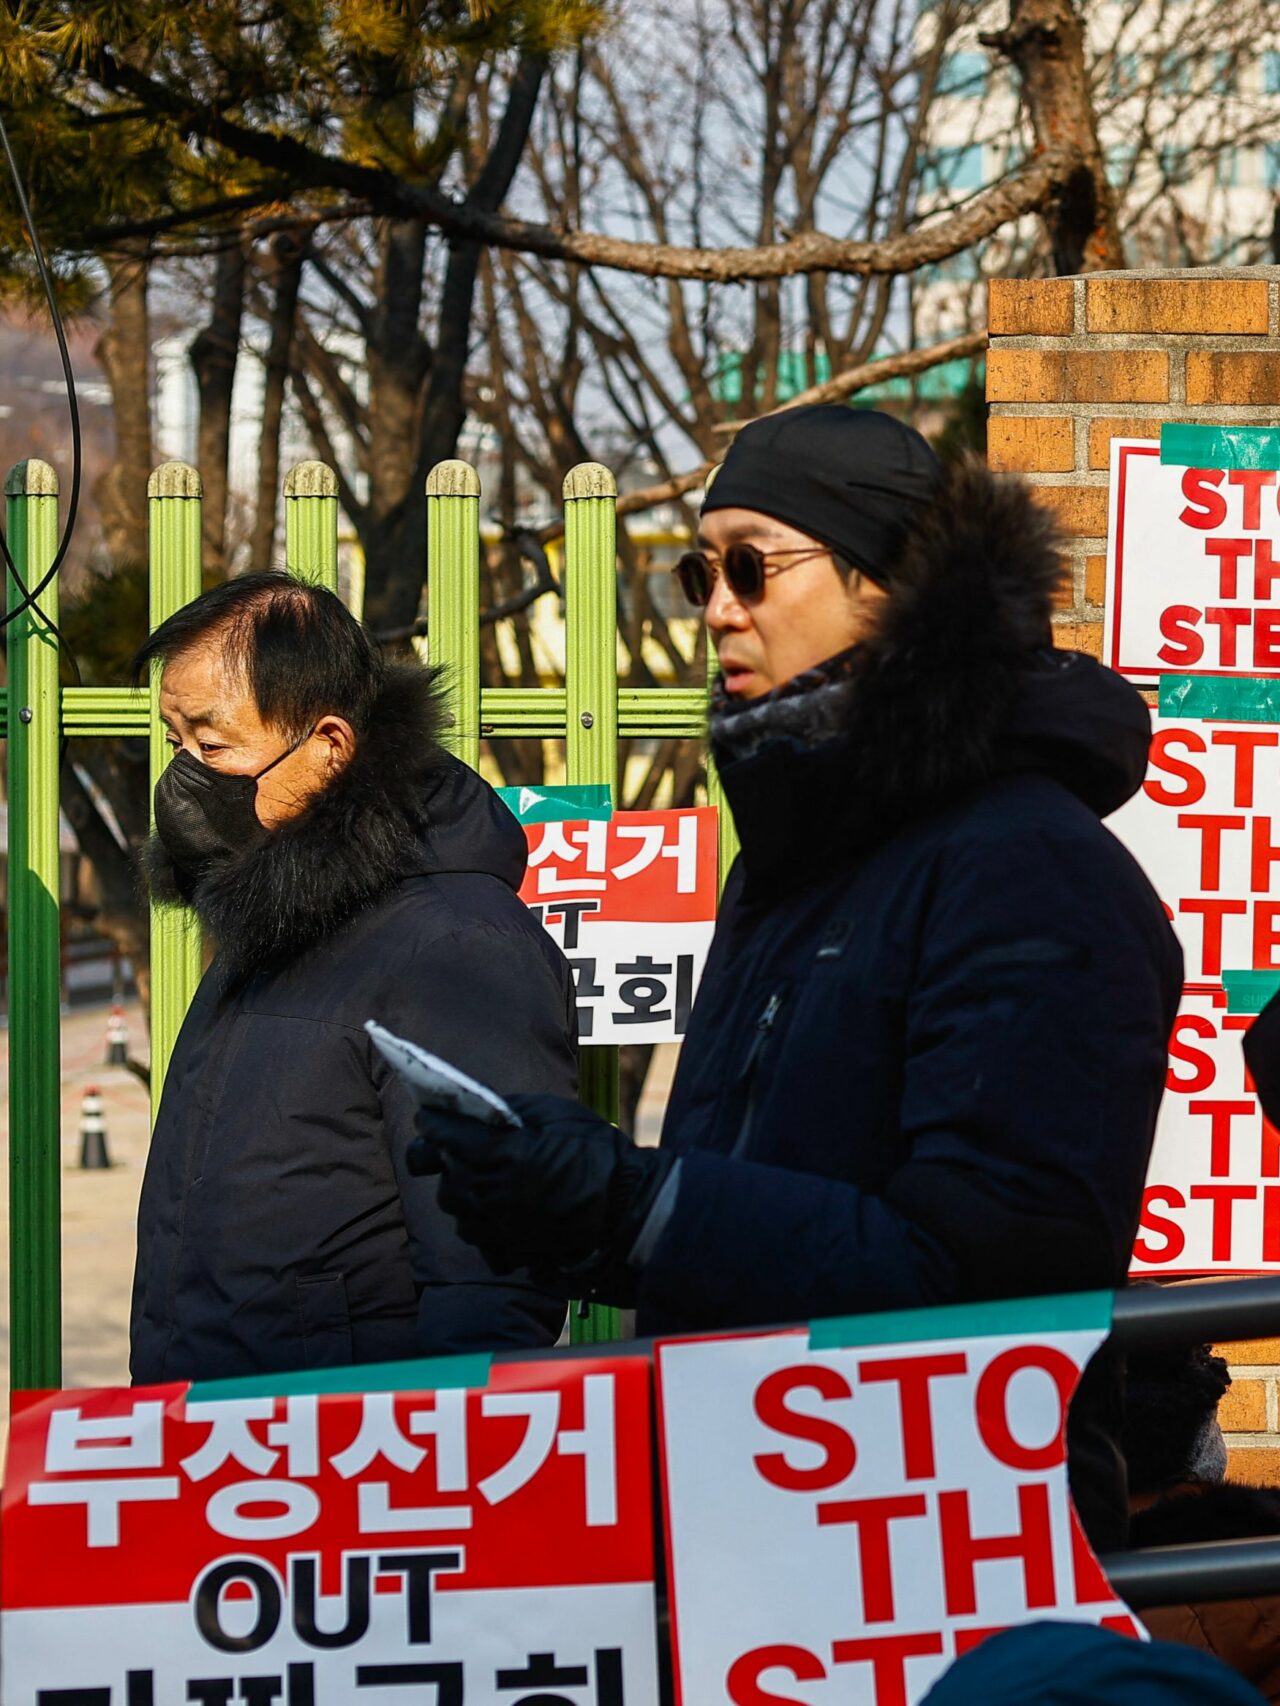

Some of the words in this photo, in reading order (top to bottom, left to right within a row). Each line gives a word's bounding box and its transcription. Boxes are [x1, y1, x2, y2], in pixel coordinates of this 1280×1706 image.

[27, 1374, 618, 1548] 부정선거
[190, 1546, 466, 1654] OUT
[816, 1483, 1115, 1625] TH
